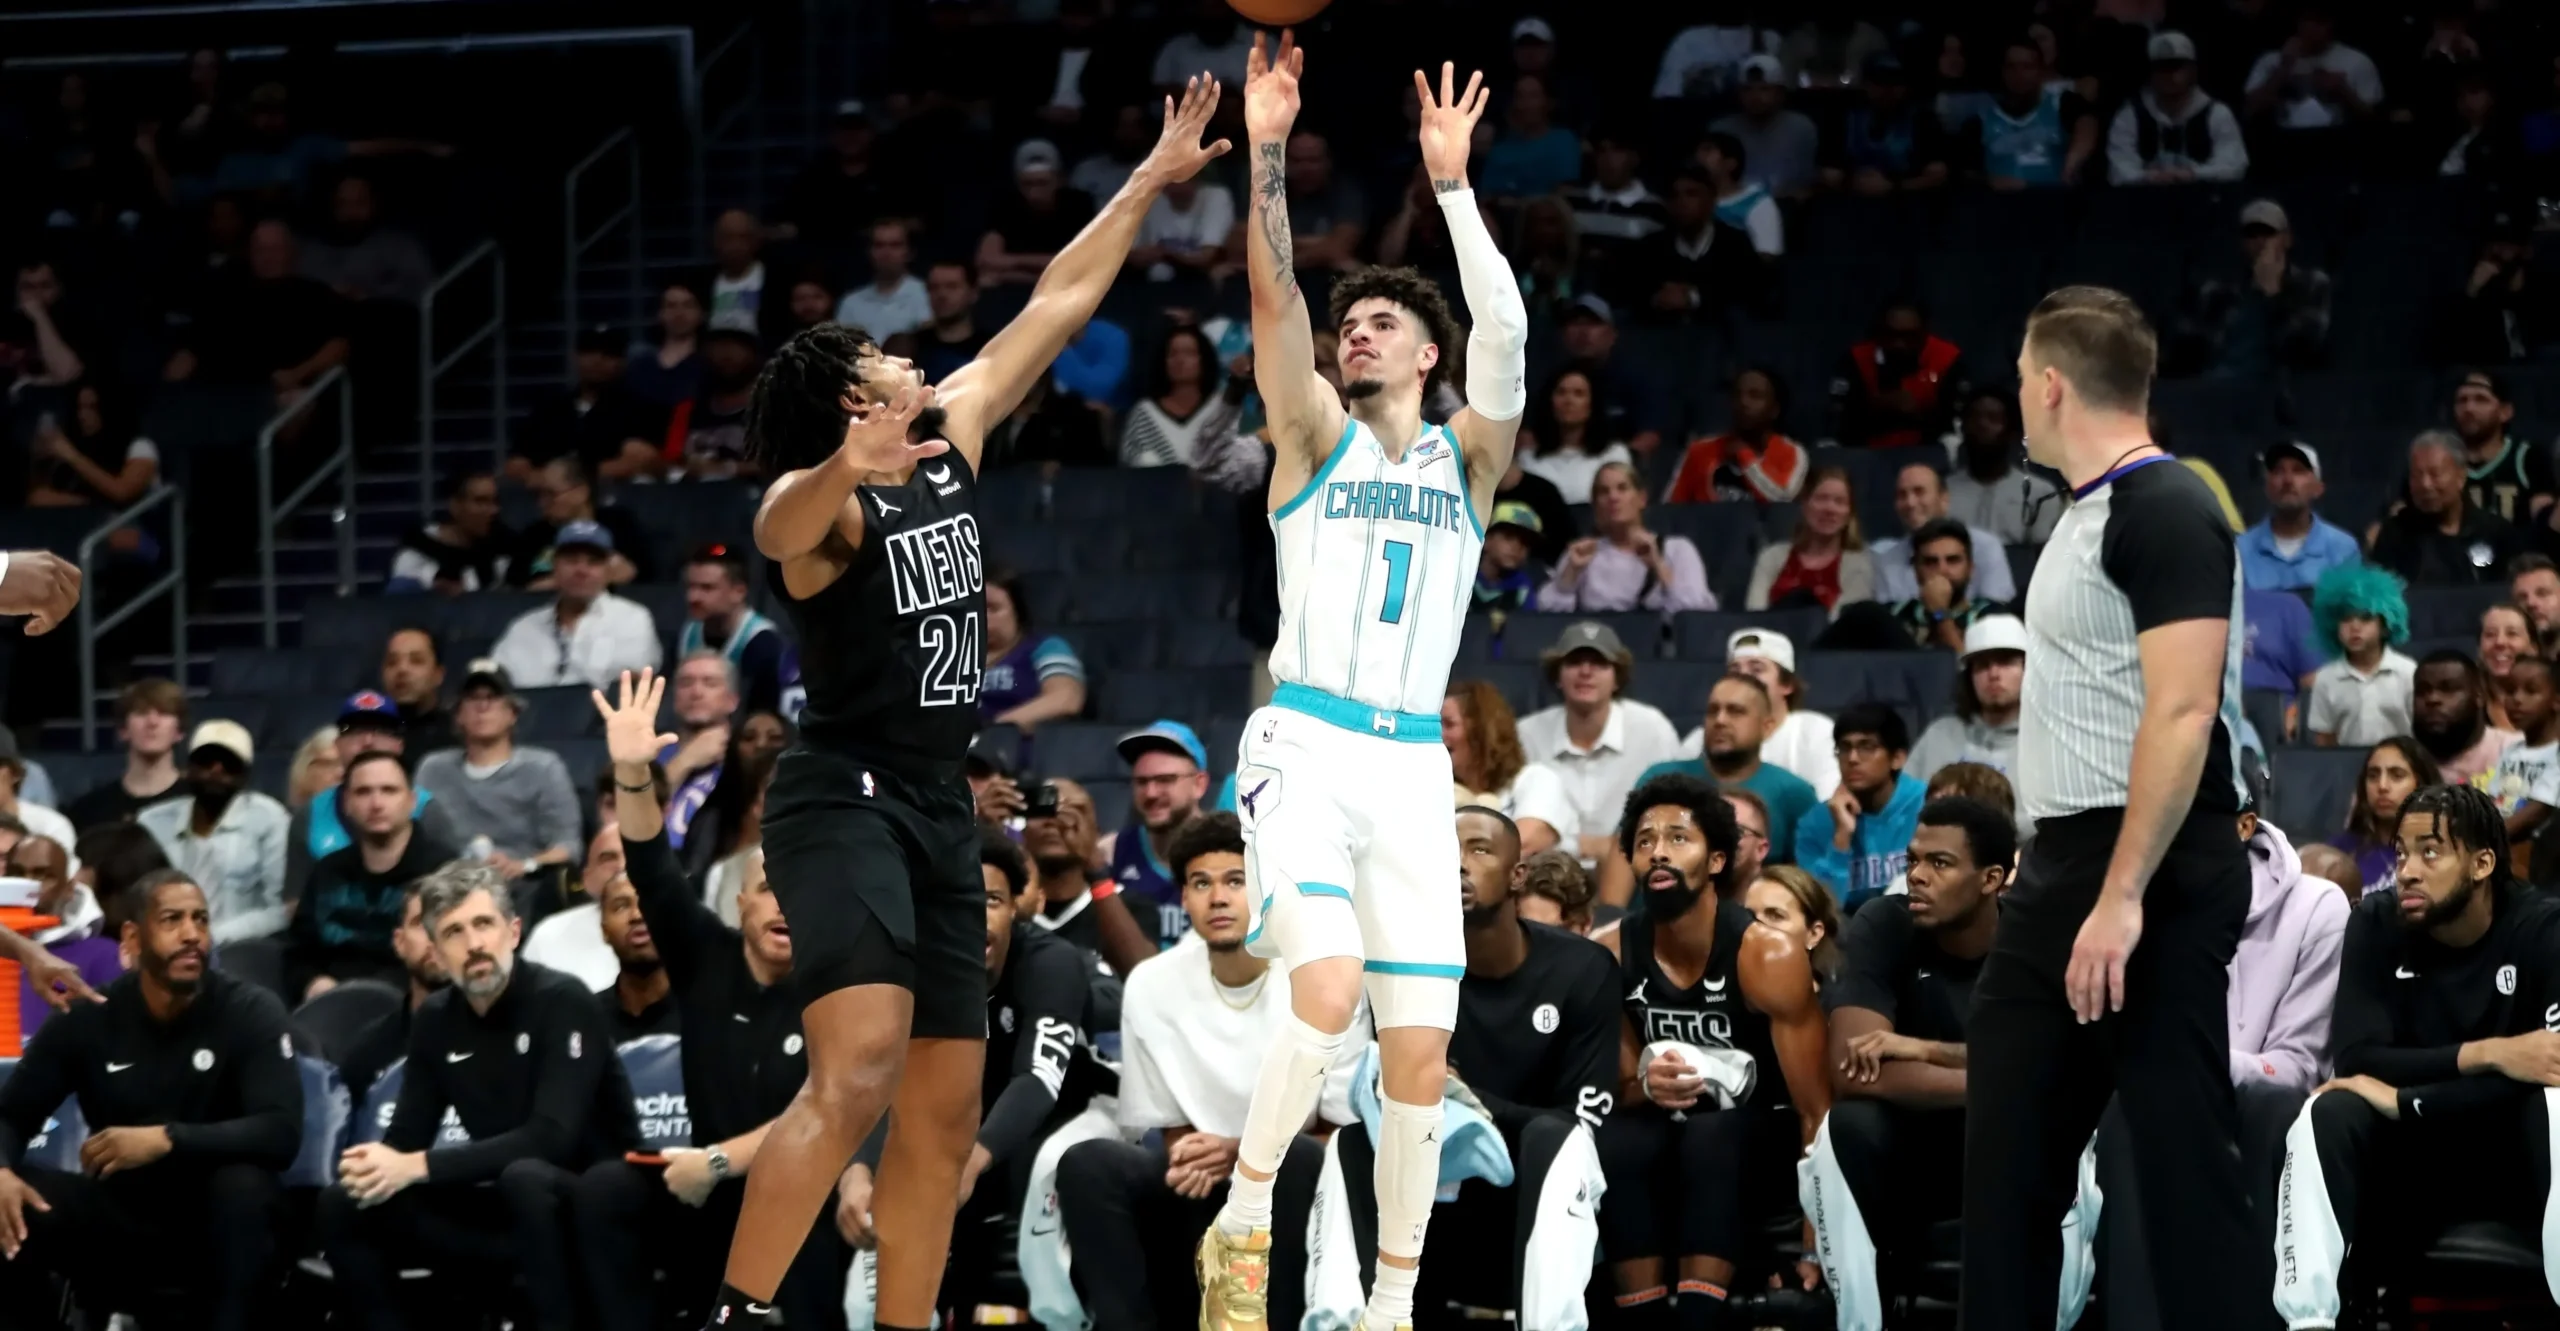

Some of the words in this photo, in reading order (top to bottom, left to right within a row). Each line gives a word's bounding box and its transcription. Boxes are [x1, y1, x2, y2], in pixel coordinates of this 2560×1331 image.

[937, 480, 962, 497] Webull
[1324, 481, 1461, 534] CHARLOTTE
[885, 512, 983, 615] NETS
[1379, 539, 1413, 625] 1
[919, 611, 982, 708] 24
[1638, 1007, 1735, 1049] ETS
[2282, 1151, 2294, 1235] BROOKLYN
[2284, 1245, 2297, 1287] NETS
